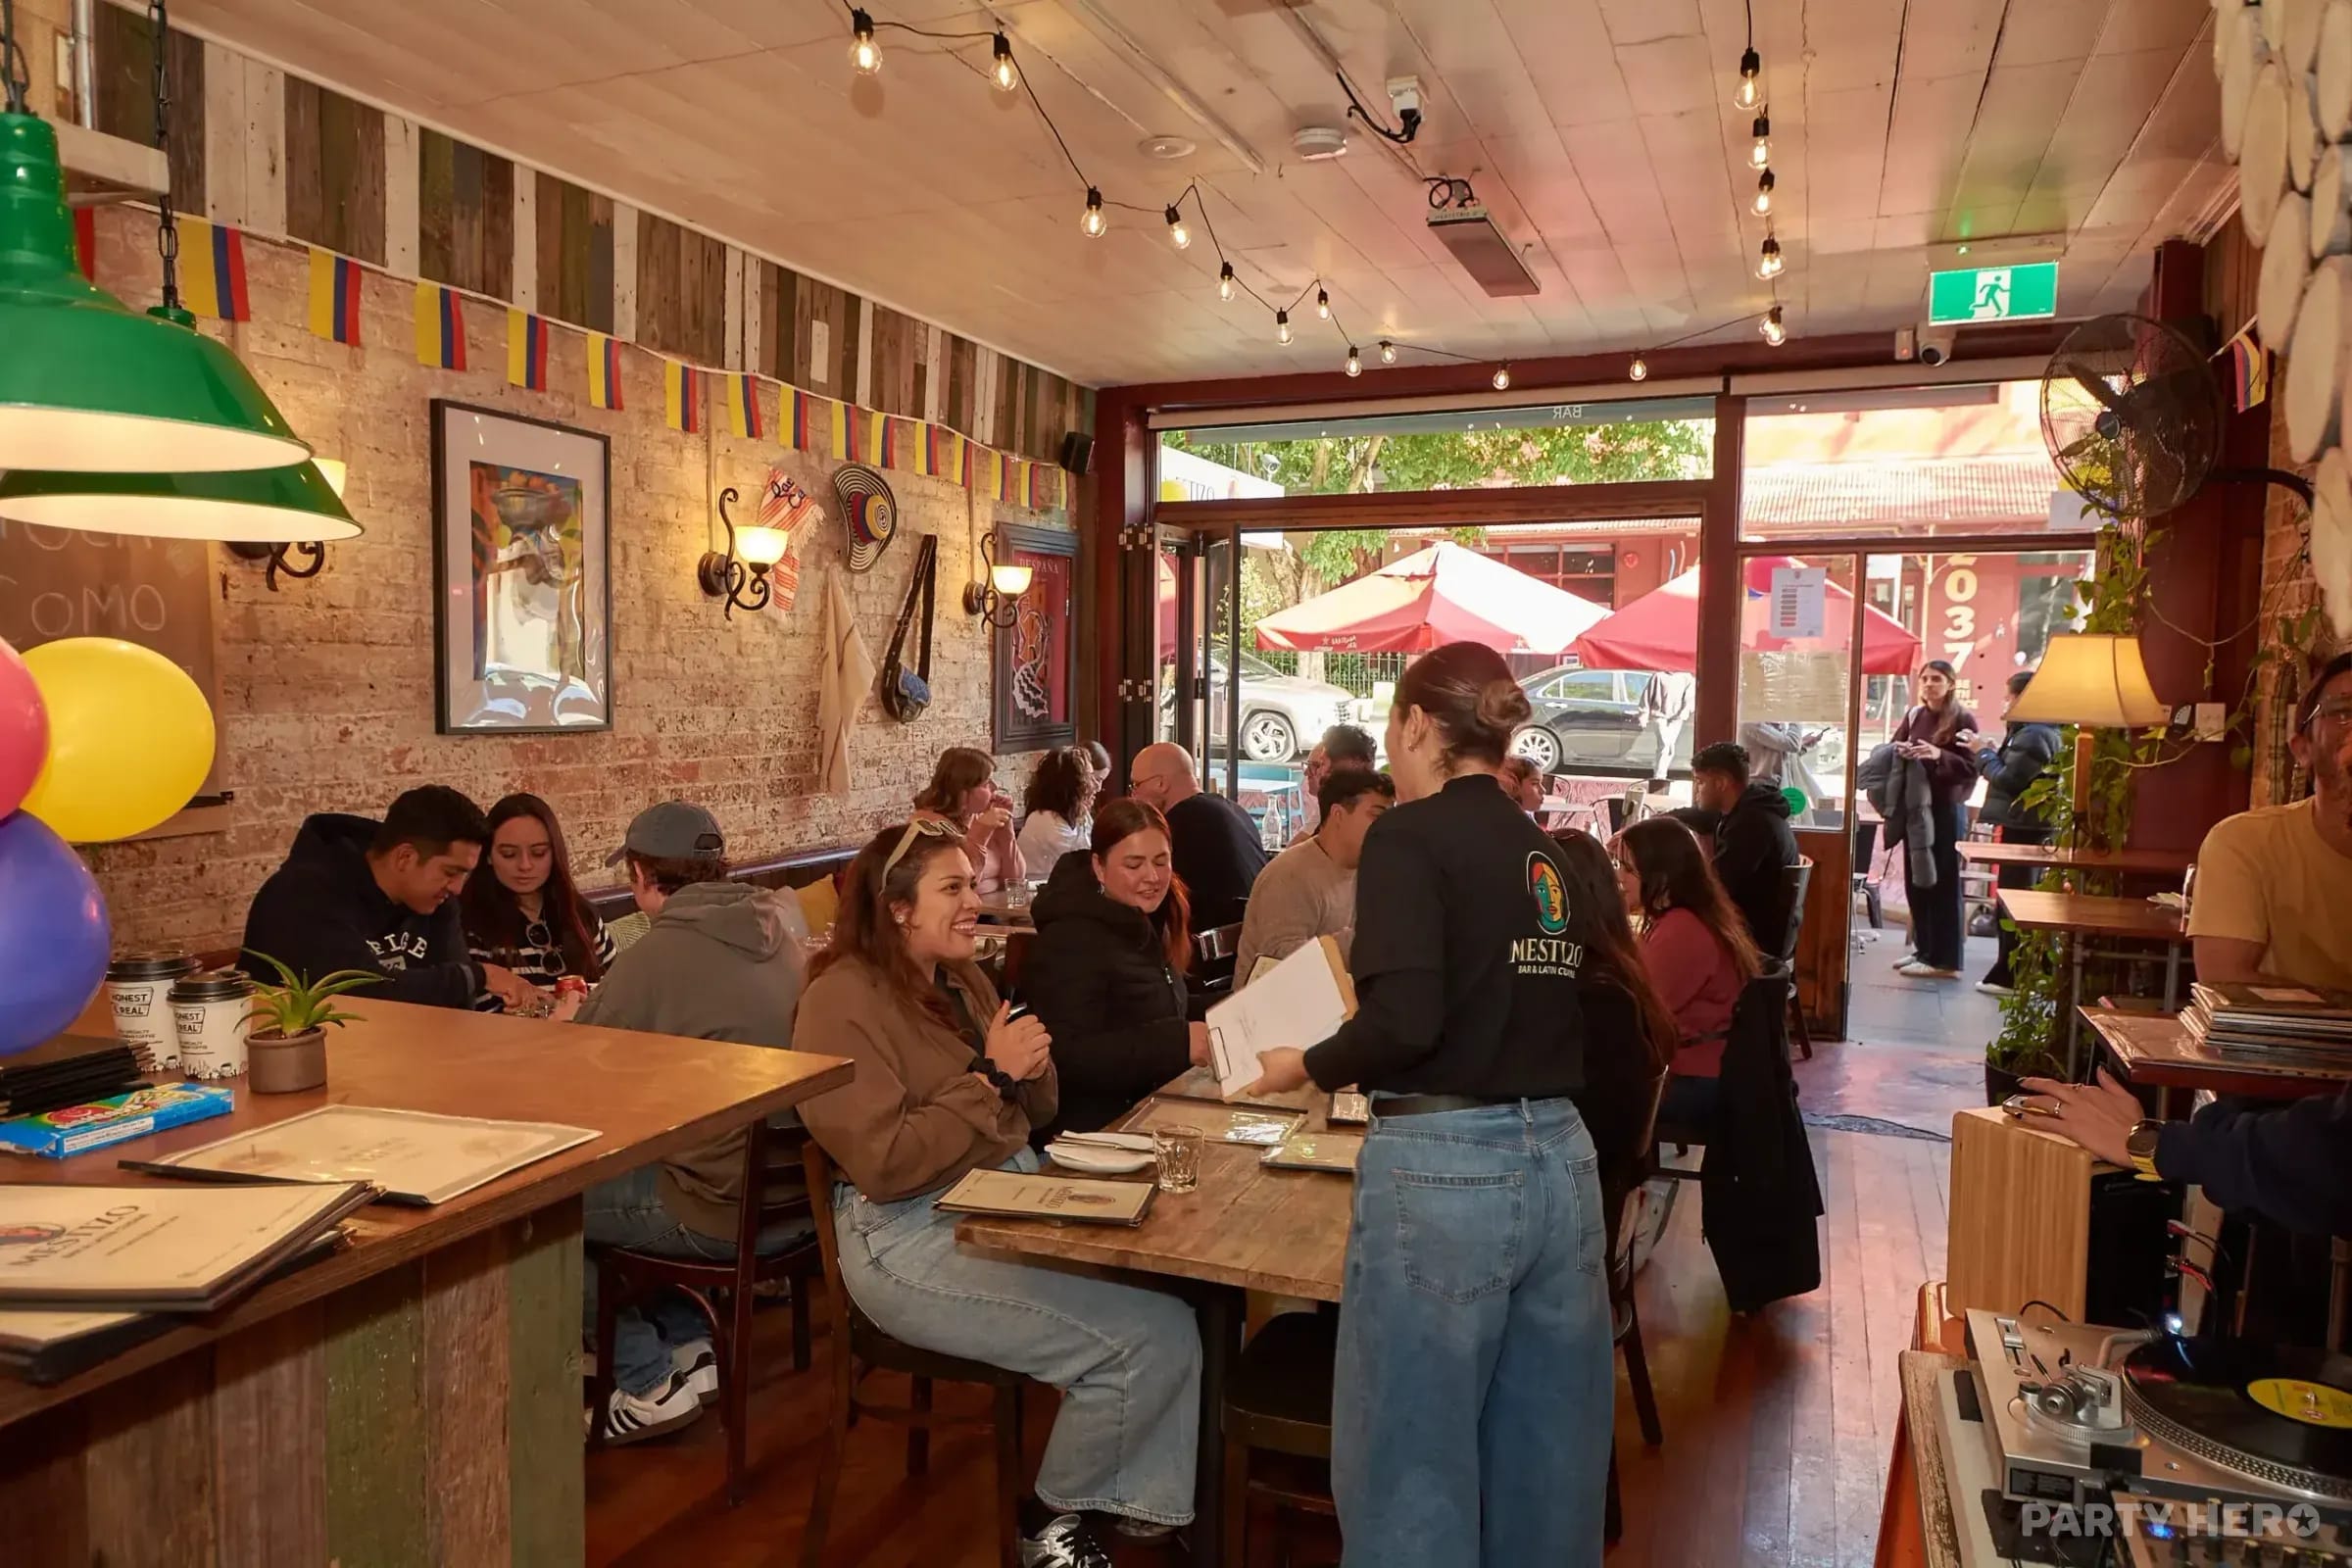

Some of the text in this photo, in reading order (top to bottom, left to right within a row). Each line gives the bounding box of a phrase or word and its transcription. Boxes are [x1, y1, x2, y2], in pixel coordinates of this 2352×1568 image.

[1518, 965, 1532, 974] BAR
[1532, 965, 1538, 974] &
[1539, 965, 1557, 974] LATIN
